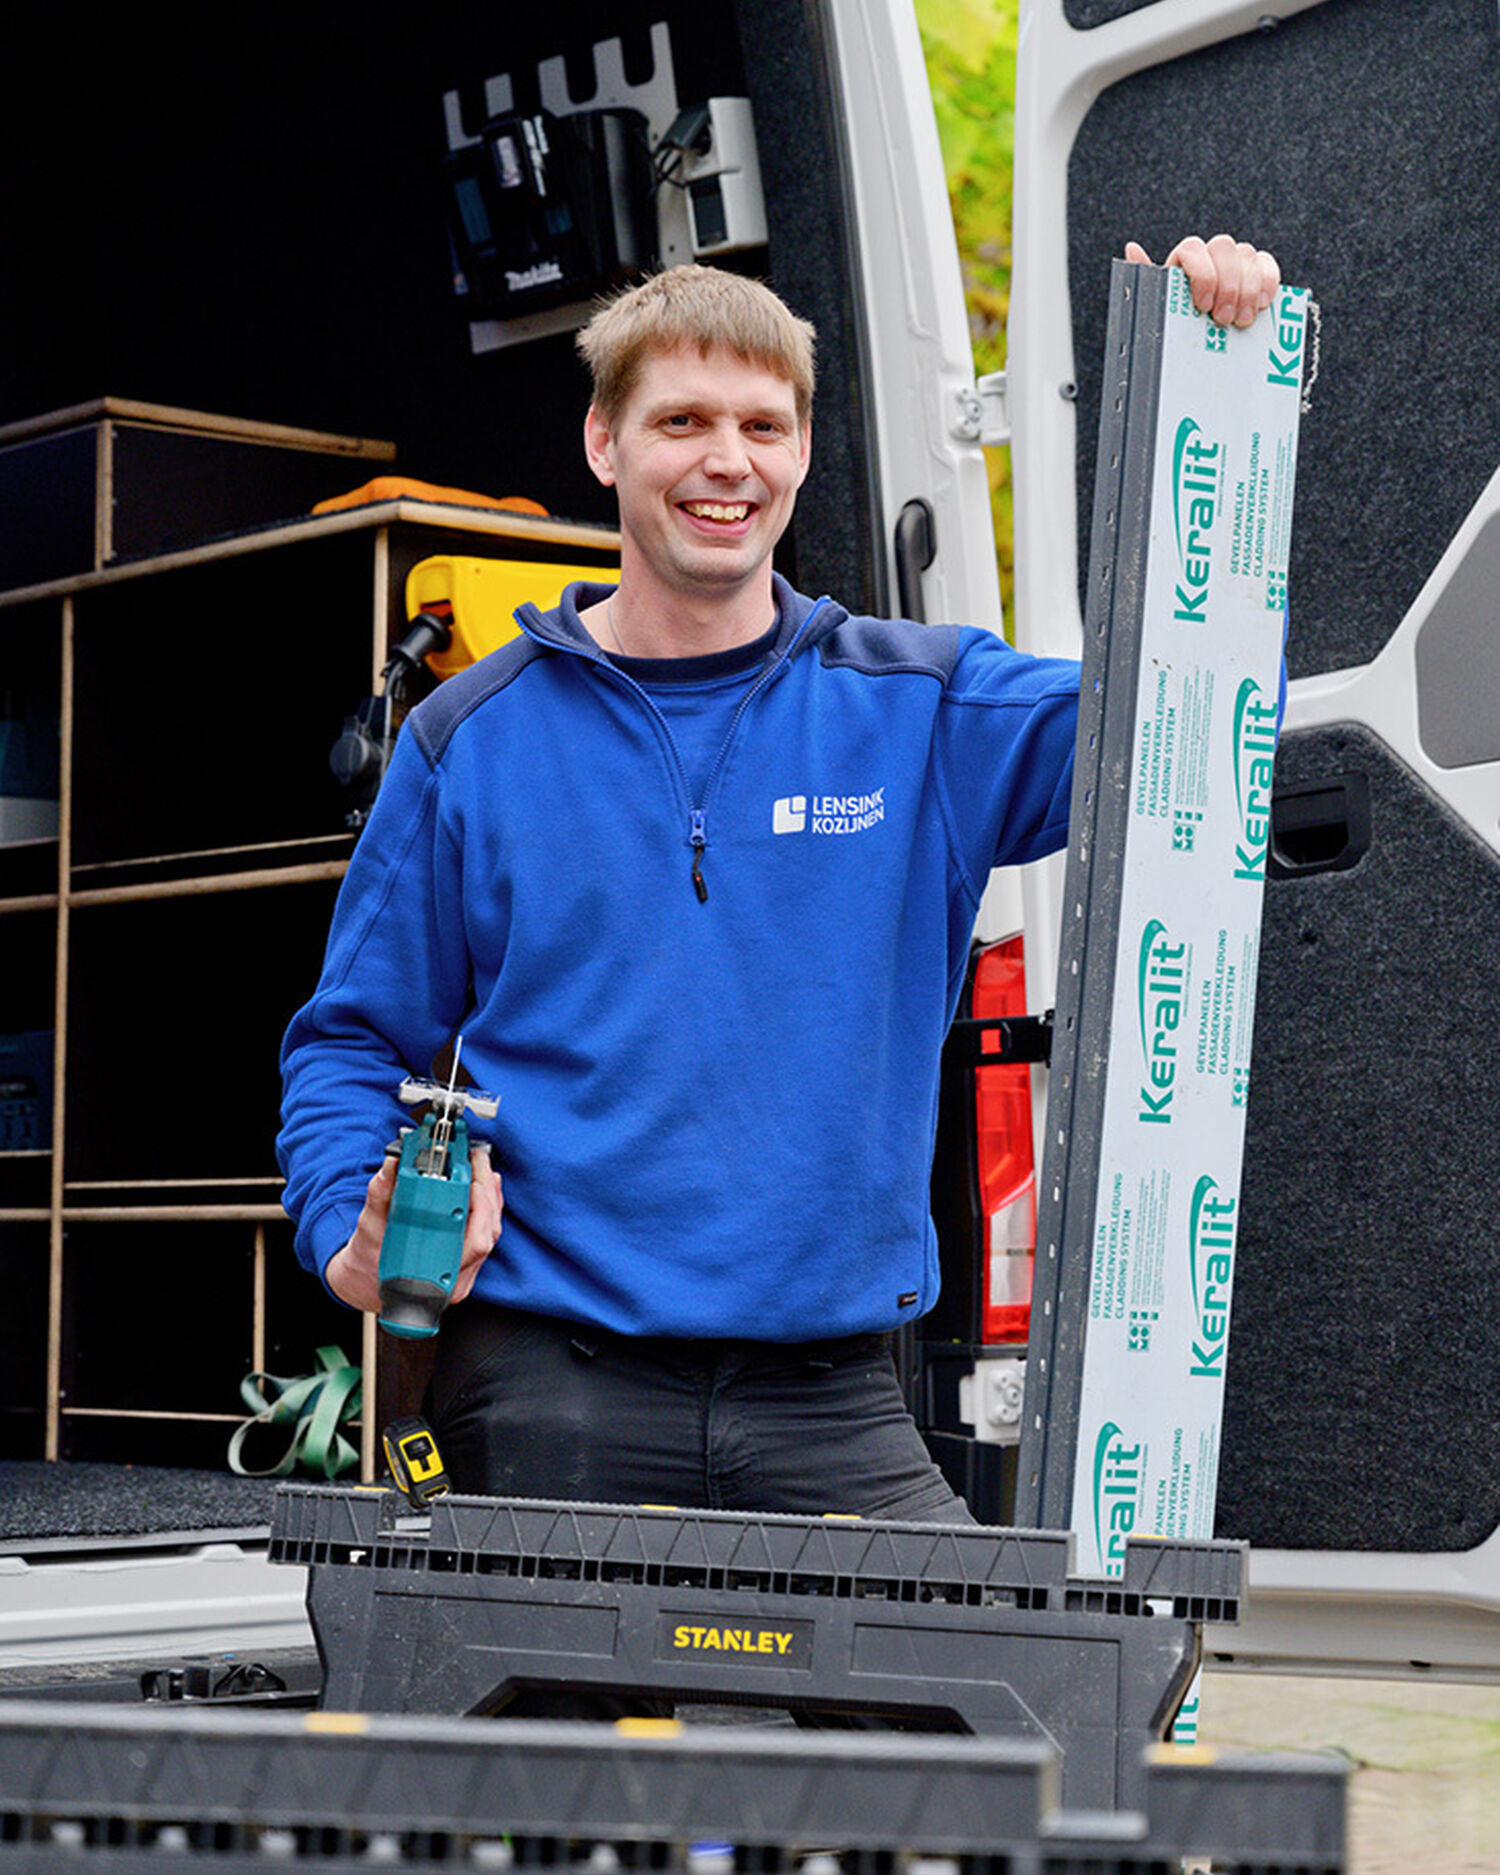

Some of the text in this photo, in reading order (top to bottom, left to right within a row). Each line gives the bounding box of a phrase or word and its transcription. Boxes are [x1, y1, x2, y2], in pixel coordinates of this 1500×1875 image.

[1174, 440, 1219, 623] Keralit
[1230, 481, 1245, 575] GEVELPANELEN
[1242, 432, 1261, 576] FASSADENVERKLEIDUNG
[1253, 469, 1269, 577] CLADDING SYSTEM
[1136, 721, 1151, 815] GEVELPANELEN
[1148, 670, 1167, 817] FASSADENVERKLEIDUNG
[1159, 708, 1176, 818] CLADDING SYSTEM
[1234, 700, 1278, 881] Keralit
[1139, 941, 1185, 1124] Keralit
[1196, 979, 1212, 1073] GEVELPANELEN
[1207, 929, 1227, 1075] FASSADENVERKLEIDUNG
[1219, 966, 1236, 1075] CLADDING SYSTEM
[1091, 1224, 1107, 1319] GEVELPANELEN
[1103, 1172, 1123, 1319] FASSADENVERKLEIDUNG
[1114, 1209, 1131, 1319] CLADDING SYSTEM
[1190, 1196, 1236, 1377] Keralit
[1105, 1443, 1140, 1577] ralit
[1181, 1464, 1191, 1508] SYSTEM
[673, 1626, 793, 1654] STANLEY
